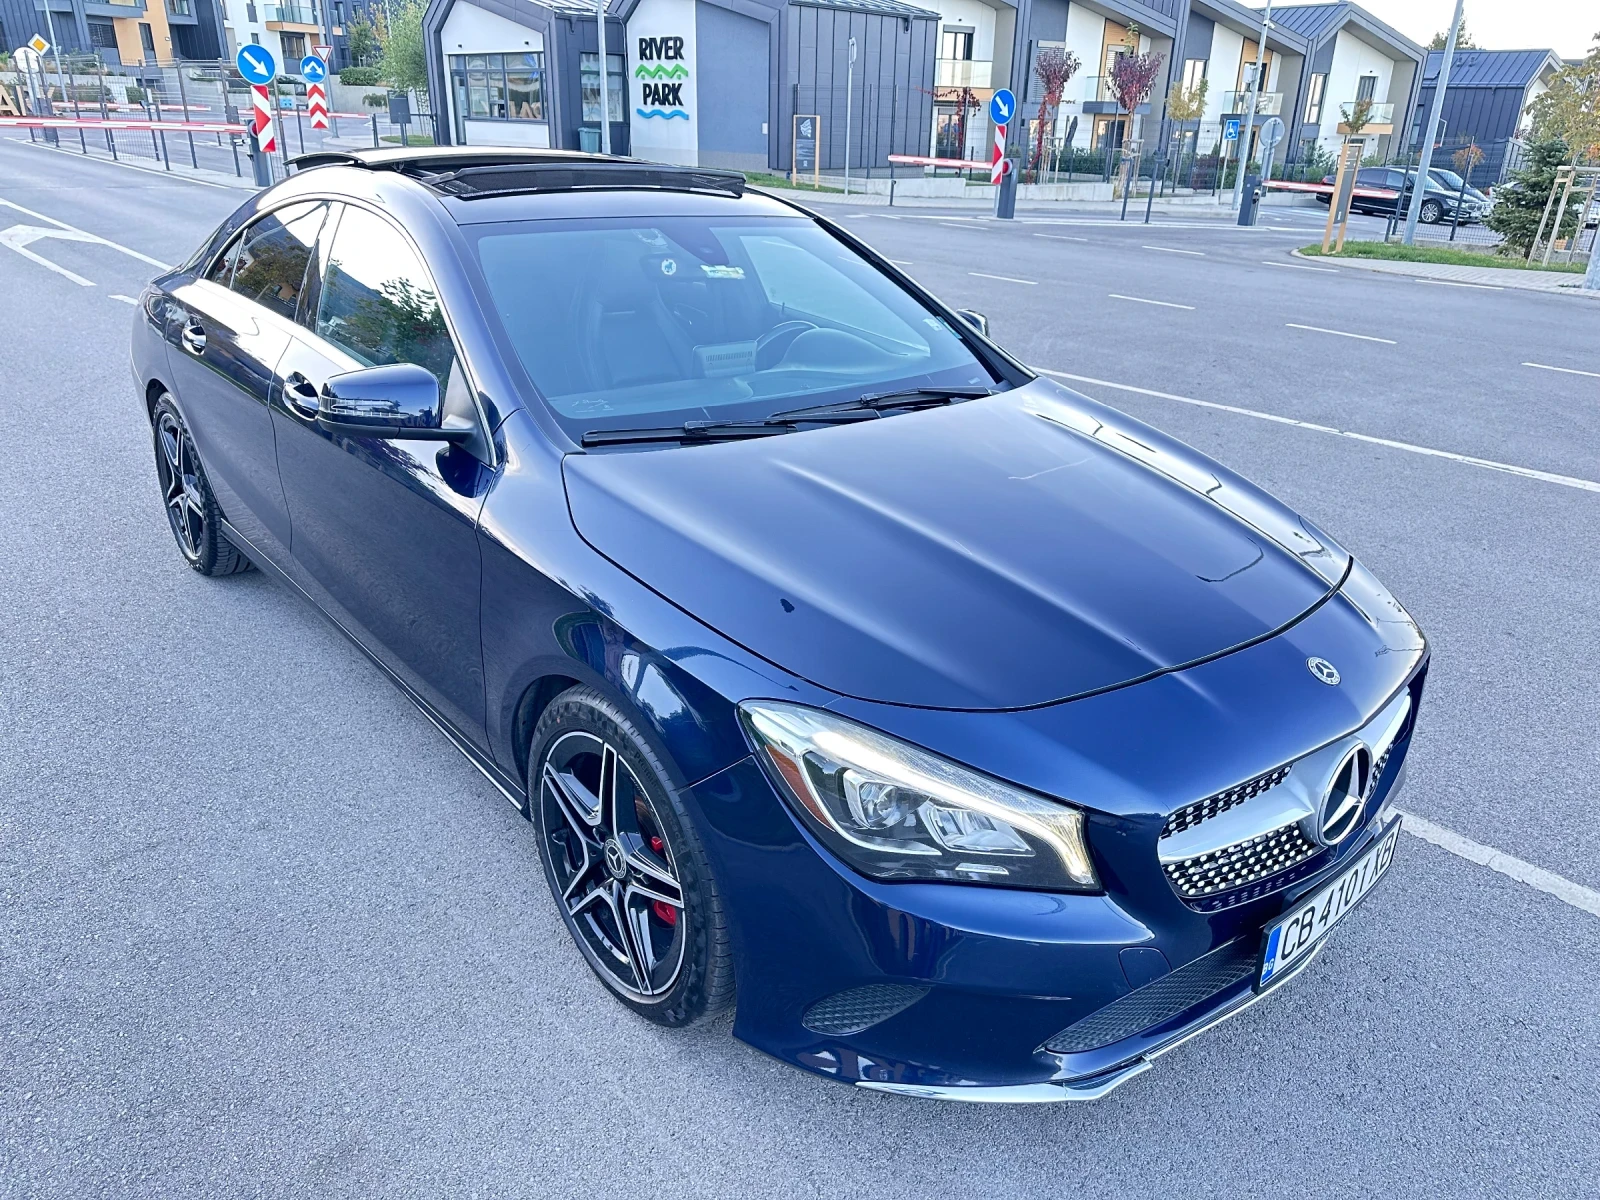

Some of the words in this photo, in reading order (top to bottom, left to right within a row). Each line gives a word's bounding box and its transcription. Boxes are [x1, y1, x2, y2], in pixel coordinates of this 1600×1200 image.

[638, 36, 685, 61] RIVER
[642, 83, 685, 107] PARK
[1281, 906, 1315, 959] CB
[1318, 861, 1369, 926] 4101
[1368, 831, 1395, 884] XB
[1262, 958, 1274, 974] BG
